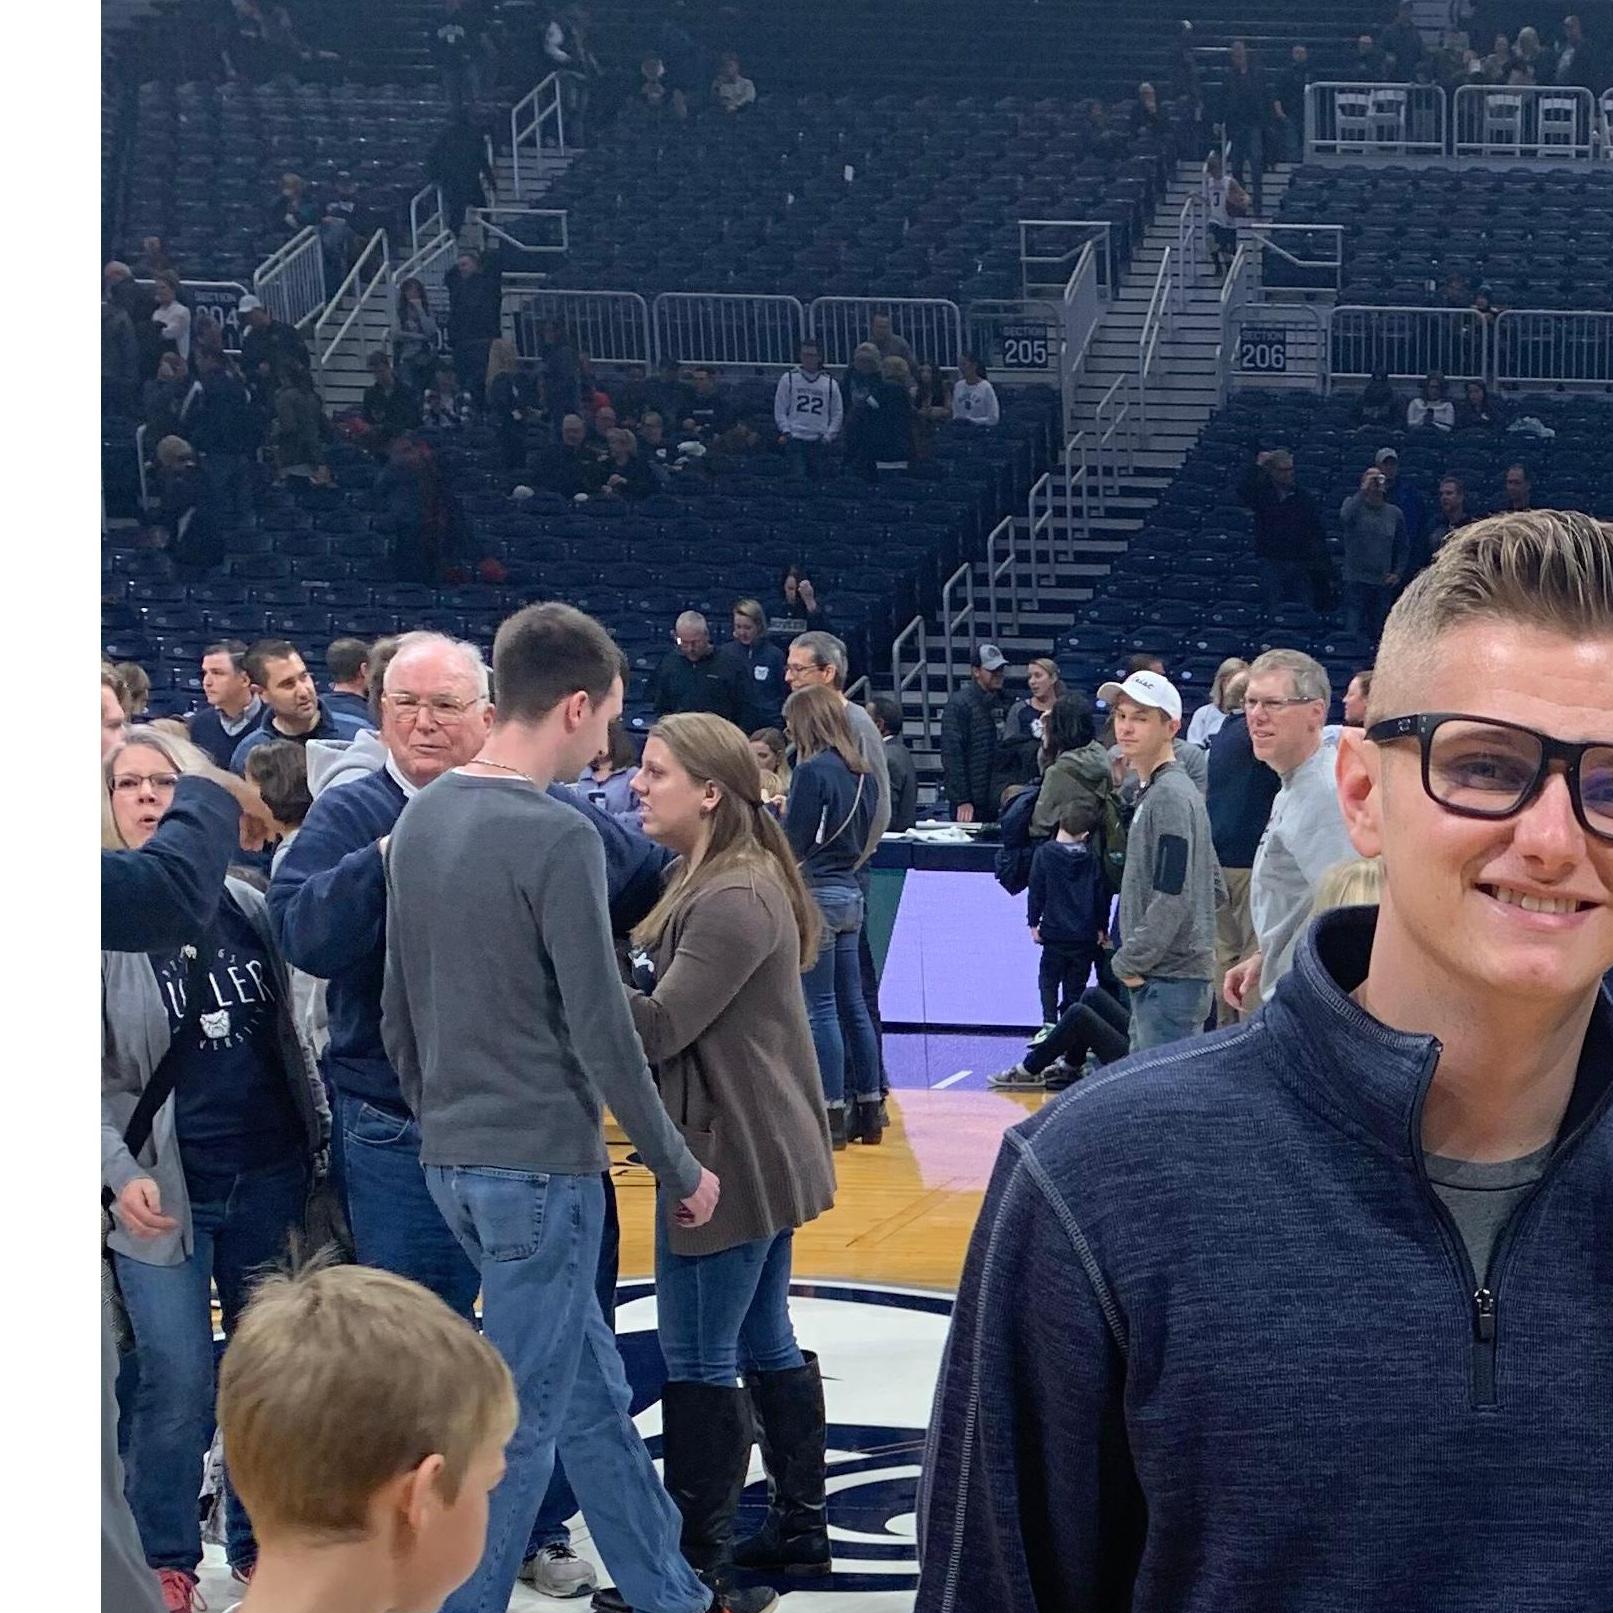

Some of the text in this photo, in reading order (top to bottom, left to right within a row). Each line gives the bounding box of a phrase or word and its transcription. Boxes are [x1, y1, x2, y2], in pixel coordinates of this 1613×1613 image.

[1003, 326, 1046, 337] SECTION
[1004, 339, 1046, 364] 205
[1242, 343, 1285, 369] 206
[796, 395, 824, 415] 22
